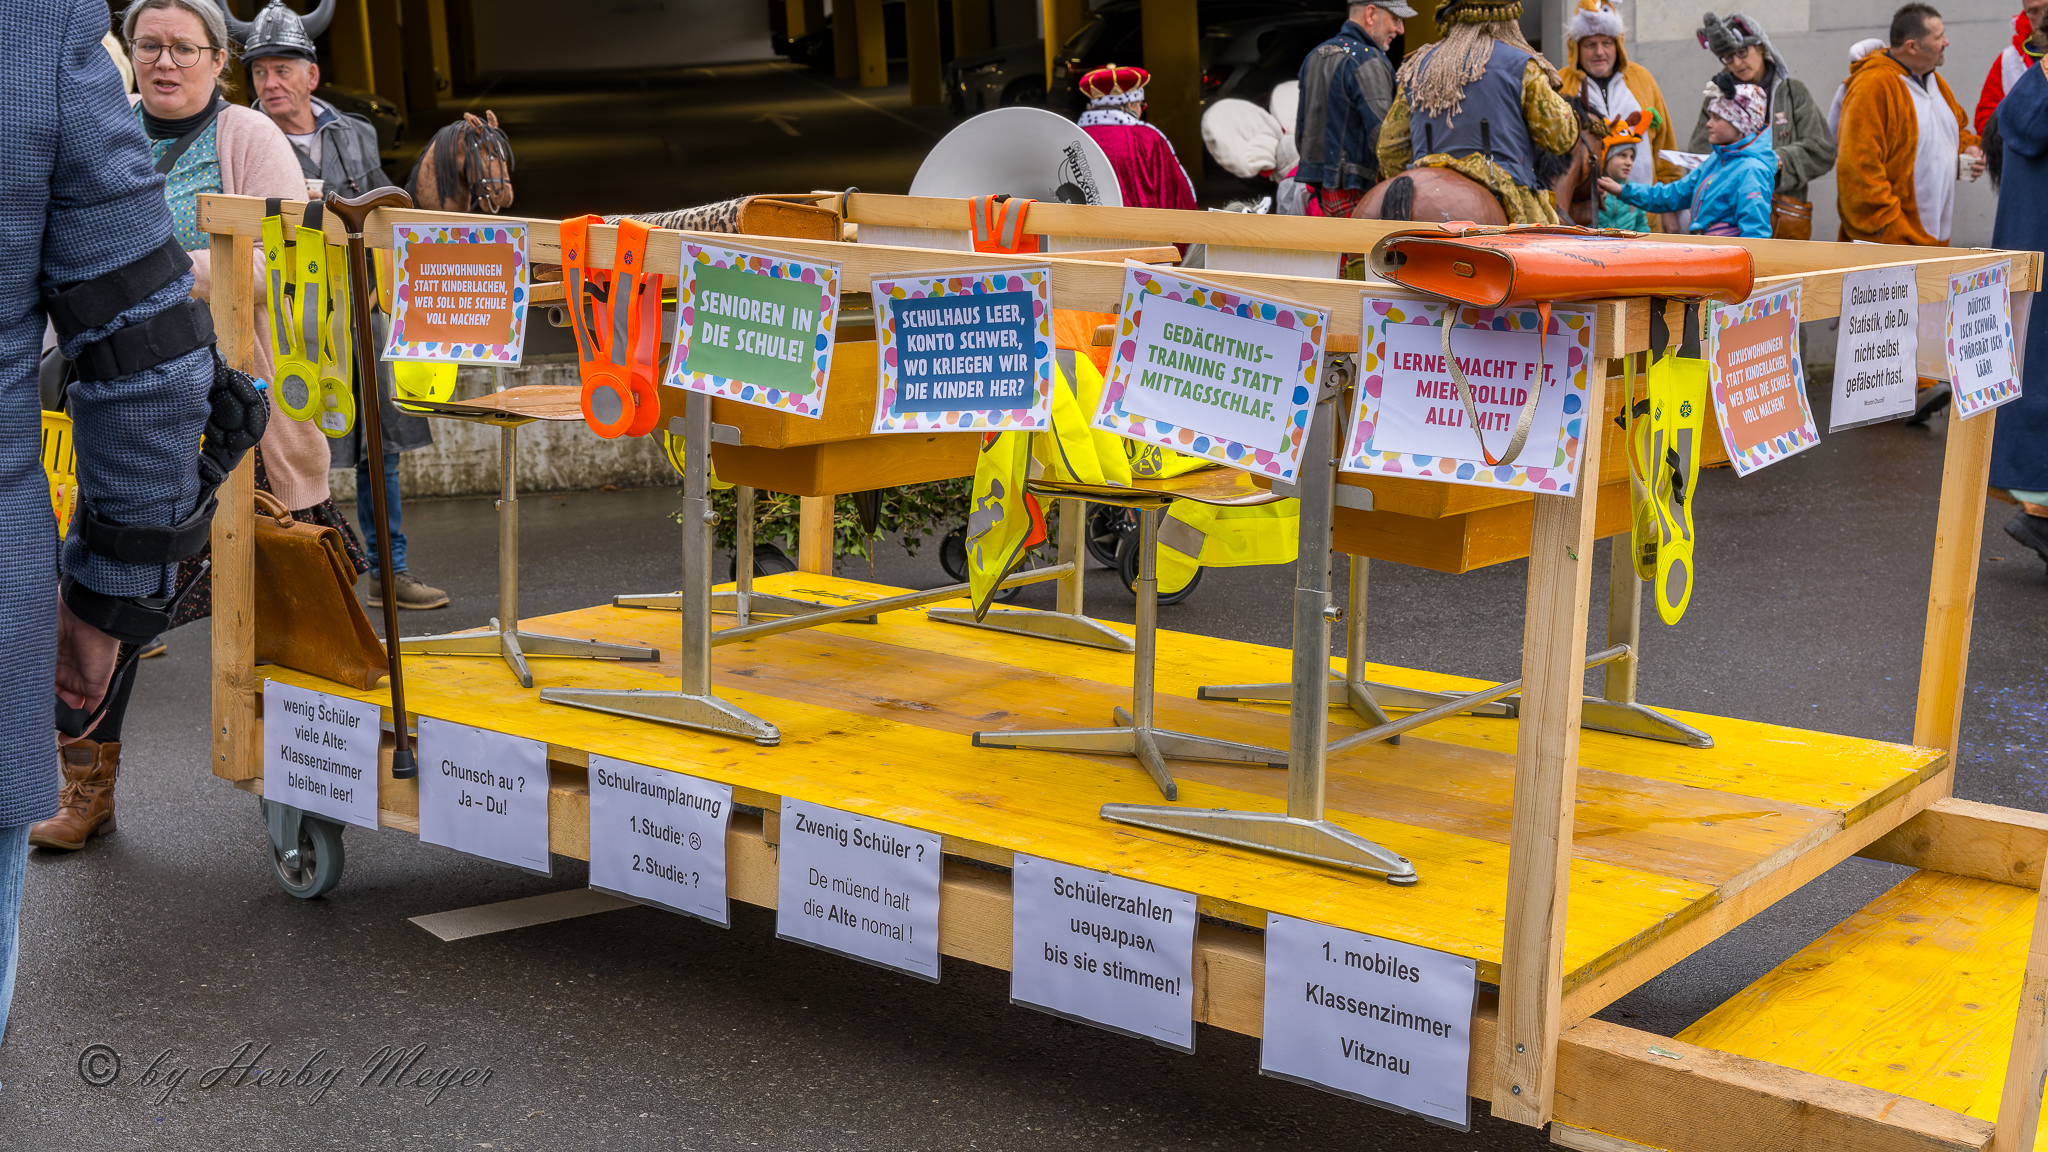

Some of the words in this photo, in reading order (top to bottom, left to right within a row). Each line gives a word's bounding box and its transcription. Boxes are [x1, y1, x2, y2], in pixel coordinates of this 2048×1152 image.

[420, 264, 502, 276] LUXUSWOHNUNGEN
[414, 280, 439, 292] STATT
[442, 281, 508, 295] KINDERLACHEN,
[1851, 284, 1876, 305] Glaube
[1879, 283, 1889, 301] nie
[1892, 281, 1908, 300] einer
[414, 296, 433, 308] WER
[436, 296, 456, 308] SOLL
[459, 297, 472, 308] DIE
[475, 298, 506, 309] SCHULE
[700, 290, 785, 327] SENIOREN
[792, 307, 813, 333] IN
[902, 306, 980, 328] SCHULHAUS
[986, 304, 1025, 325] LEER,
[1968, 295, 1990, 316] DÜÜTSCH
[426, 313, 446, 324] VOLL
[450, 314, 490, 326] MACHEN?
[1849, 312, 1882, 335] Statistik,
[1885, 310, 1895, 330] die
[1898, 309, 1908, 327] Du
[1960, 322, 1972, 339] ISCH
[1974, 314, 1998, 335] SCHWÄR,
[702, 321, 730, 348] DIE
[735, 329, 804, 363] SCHULE!
[907, 333, 954, 352] KONTO
[960, 330, 1023, 350] SCHWER,
[1728, 336, 1783, 367] LUXUSWOHNUNGEN
[1855, 343, 1875, 363] nicht
[1877, 339, 1899, 360] selbst
[1991, 334, 2003, 351] ISCH
[904, 359, 927, 376] WO
[933, 355, 993, 375] KRIEGEN
[999, 354, 1028, 372] WIR
[1149, 344, 1226, 381] TRAINING
[1231, 367, 1283, 395] STATT
[1456, 357, 1517, 380] MACHT
[1524, 363, 1557, 387] FT,
[1726, 369, 1743, 388] STATT
[1746, 354, 1789, 381] KINDERLACHEN,
[1976, 359, 1993, 378] LÄÄR!
[905, 383, 928, 400] DIE
[933, 380, 984, 399] KINDER
[990, 379, 1025, 397] HER?
[1140, 369, 1276, 422] MITTAGSSCHLAF.
[1416, 380, 1458, 401] MIER
[1469, 385, 1527, 407] ROLLID
[1729, 390, 1744, 408] WER
[1745, 385, 1759, 402] SOLL
[1760, 381, 1770, 395] DIE
[1771, 373, 1791, 390] SCHULE
[1846, 370, 1883, 398] gefälscht
[1886, 366, 1904, 386] hast.
[1425, 407, 1464, 428] ALLI
[1469, 412, 1510, 432] MIT!
[1742, 407, 1759, 424] VOLL
[1759, 396, 1785, 419] MACHEN?
[283, 700, 314, 721] wenig
[318, 704, 360, 728] Schüler
[295, 725, 319, 744] viele
[322, 731, 347, 751] Alte:
[281, 744, 362, 780] Klassenzimmer
[442, 760, 494, 786] Chunsch
[498, 776, 513, 790] au
[518, 776, 525, 792] ?
[288, 772, 326, 796] bleiben
[330, 783, 353, 803] leer!
[598, 769, 721, 818] Schulraumplanung
[459, 790, 471, 807] Ja
[487, 796, 507, 815] Du!
[796, 813, 848, 847] Zwenig
[853, 828, 911, 859] Schüler
[916, 844, 924, 862] ?
[692, 872, 700, 888] ?
[809, 868, 828, 888] De
[832, 878, 879, 903] müend
[884, 888, 909, 912] halt
[1054, 877, 1172, 923] Schülerzahlen
[804, 898, 823, 918] die
[828, 905, 857, 927] Alte
[862, 917, 903, 941] nomal
[909, 926, 912, 943] !
[1071, 918, 1155, 953] verdrehen
[1044, 942, 1068, 965] bis
[1074, 952, 1097, 973] sie
[1103, 961, 1181, 996] stimmen!
[1322, 942, 1337, 963] 1.
[1344, 950, 1420, 983] mobiles
[1306, 982, 1451, 1038] Klassenzimmer
[1341, 1037, 1410, 1075] Vitznau
